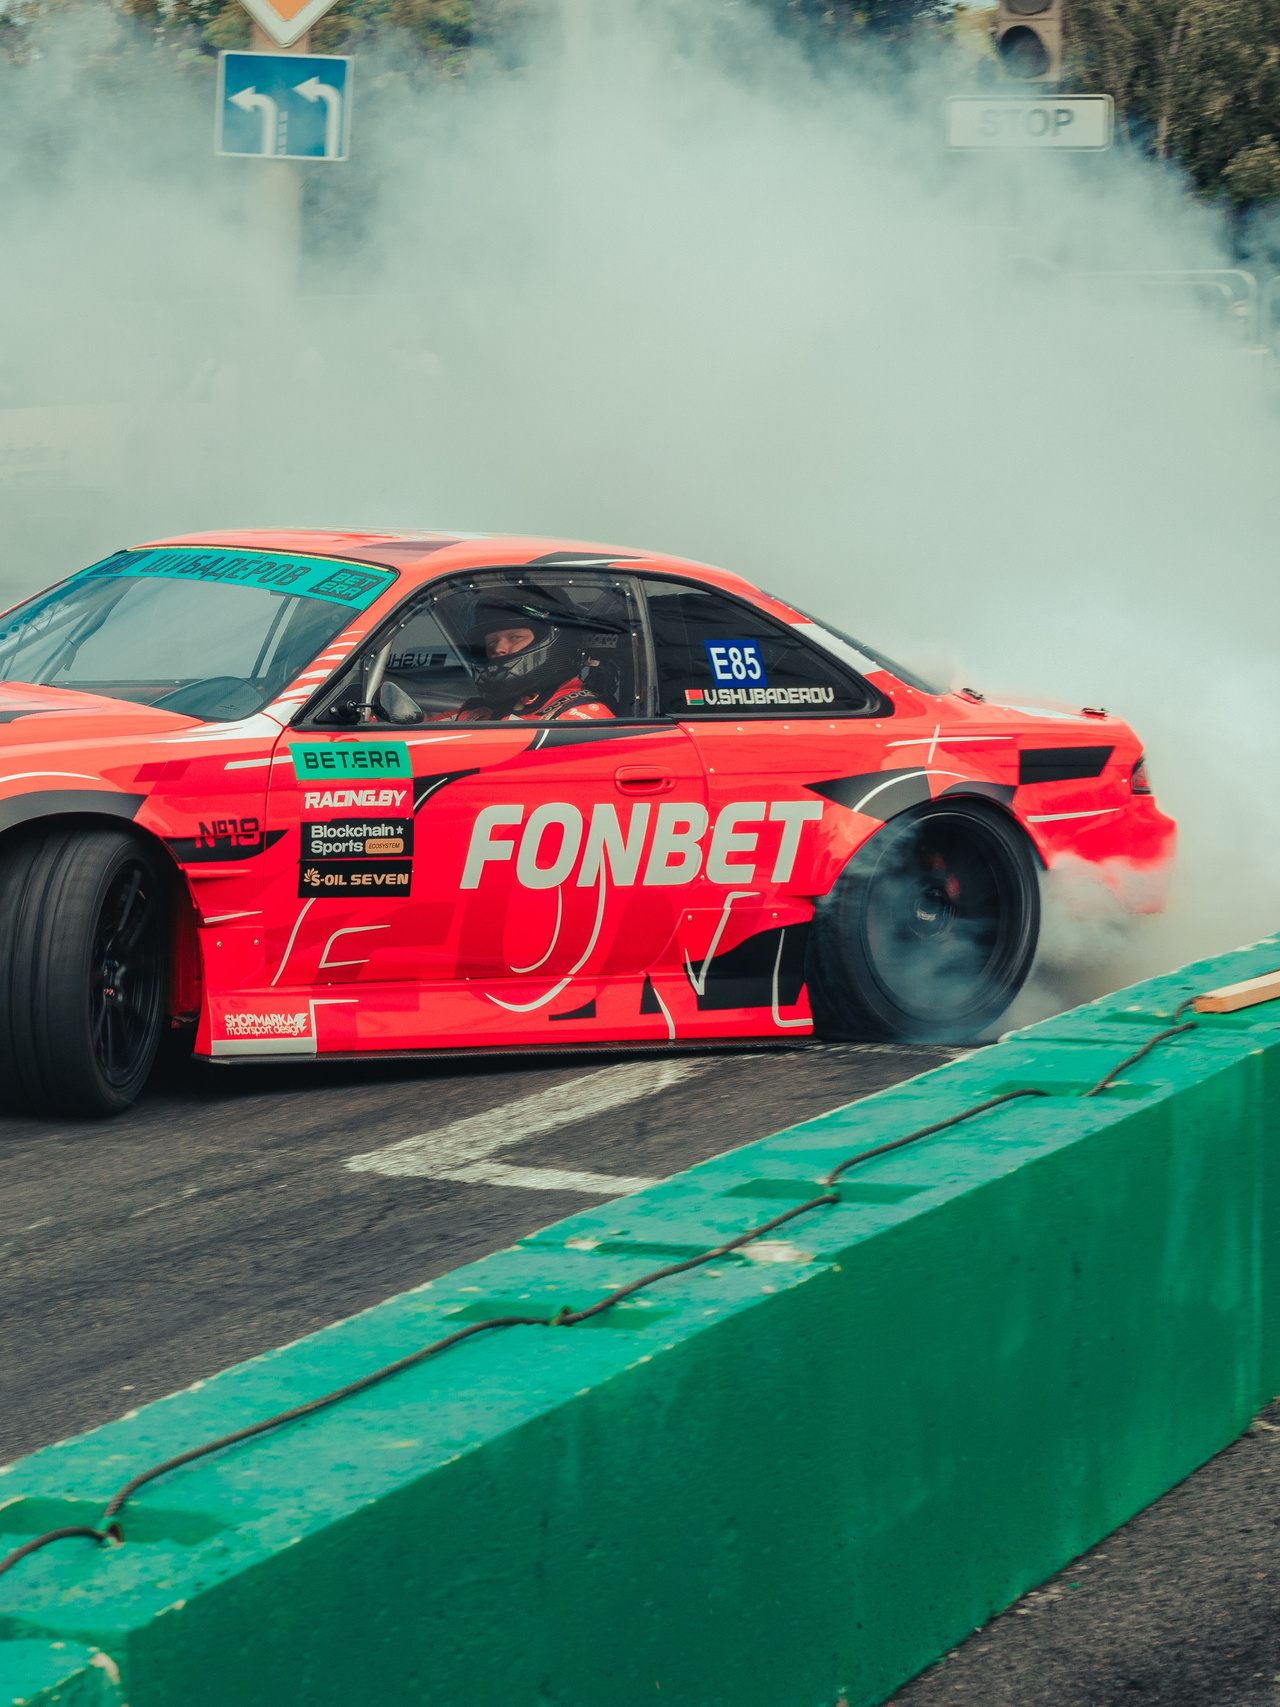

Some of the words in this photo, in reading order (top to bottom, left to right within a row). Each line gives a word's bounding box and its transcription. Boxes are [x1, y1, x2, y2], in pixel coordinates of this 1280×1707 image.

[978, 108, 1075, 138] STOP
[139, 554, 312, 586] ШУБАДЁРОВ
[331, 572, 378, 588] BET
[710, 647, 762, 680] E85
[704, 687, 835, 705] V.SHUBADEROV
[304, 790, 408, 809] RACING.BY
[311, 824, 394, 838] Blockchain
[311, 840, 364, 855] Sports
[368, 842, 401, 850] ECOSYSTEM
[459, 801, 824, 890] FONBET
[350, 873, 410, 886] SEVEN
[224, 1013, 297, 1028] SHOPMARKA
[226, 1025, 274, 1037] motorsport
[273, 1024, 302, 1036] design
